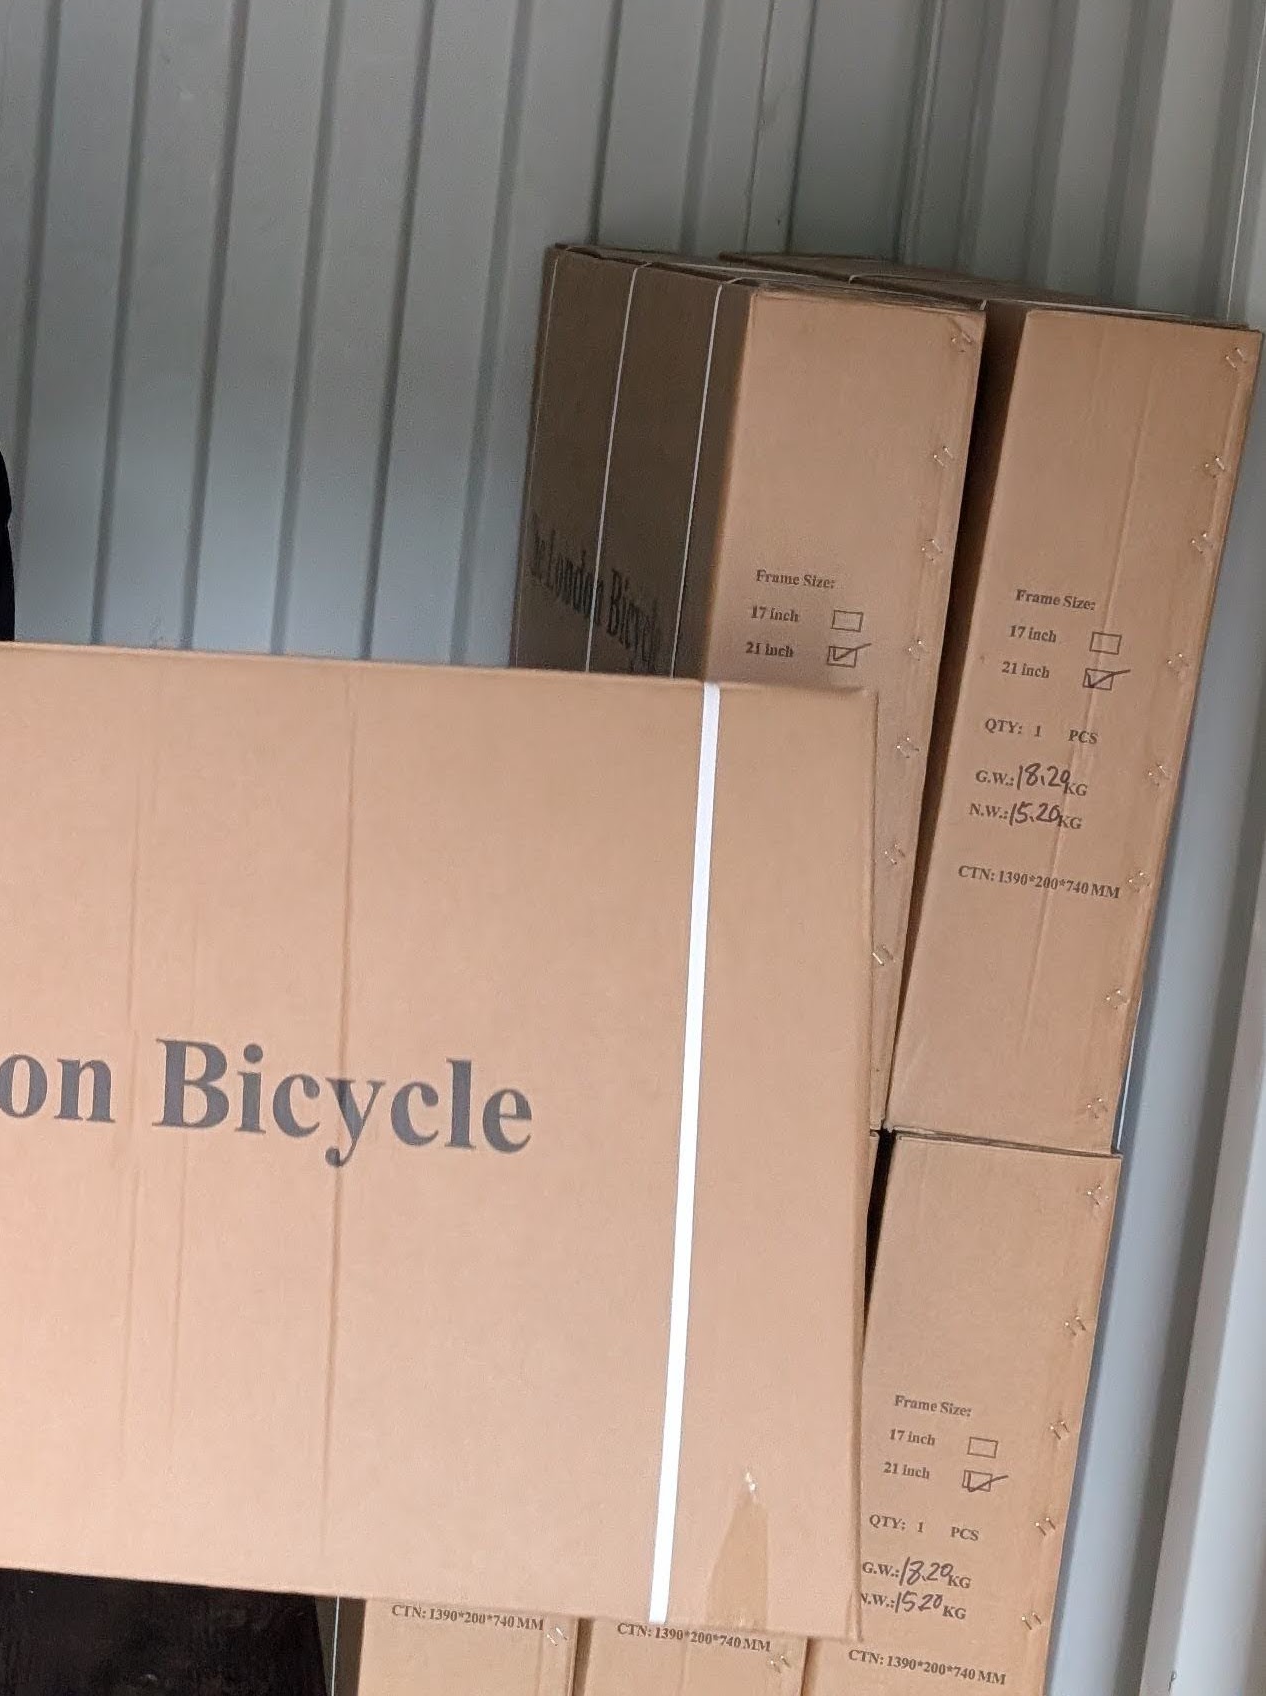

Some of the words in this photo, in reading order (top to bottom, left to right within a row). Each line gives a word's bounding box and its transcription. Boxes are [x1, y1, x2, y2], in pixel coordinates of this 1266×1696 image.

[756, 569, 800, 586] Frame
[803, 574, 835, 589] Size:
[1015, 589, 1061, 607] Frame
[1062, 595, 1096, 611] Size:
[751, 605, 767, 619] 17
[770, 607, 799, 622] inch
[1009, 624, 1026, 638] 17
[1027, 626, 1057, 643] inch
[745, 641, 762, 655] 21
[765, 643, 794, 658] inch
[1002, 661, 1019, 675] 21
[1021, 663, 1050, 679] inch
[984, 718, 1023, 735] QTY:
[1034, 725, 1042, 737] 1
[1068, 729, 1098, 745] PCS
[958, 865, 995, 882] CTN:
[1091, 884, 1121, 899] MM
[154, 1037, 533, 1169] Bicycle
[894, 1394, 938, 1413] Frame
[940, 1402, 972, 1418] Size:
[889, 1428, 905, 1441] 17
[907, 1432, 935, 1446] inch
[884, 1462, 900, 1474] 21
[902, 1465, 930, 1480] inch
[869, 1513, 906, 1531] QTY:
[917, 1522, 924, 1532] 1
[951, 1526, 980, 1542] PCS
[391, 1604, 427, 1620] CTN:
[516, 1617, 544, 1632] MM
[617, 1622, 652, 1640] CTN:
[742, 1638, 771, 1653] MM
[848, 1649, 884, 1666] CTN:
[978, 1671, 1006, 1686] MM
